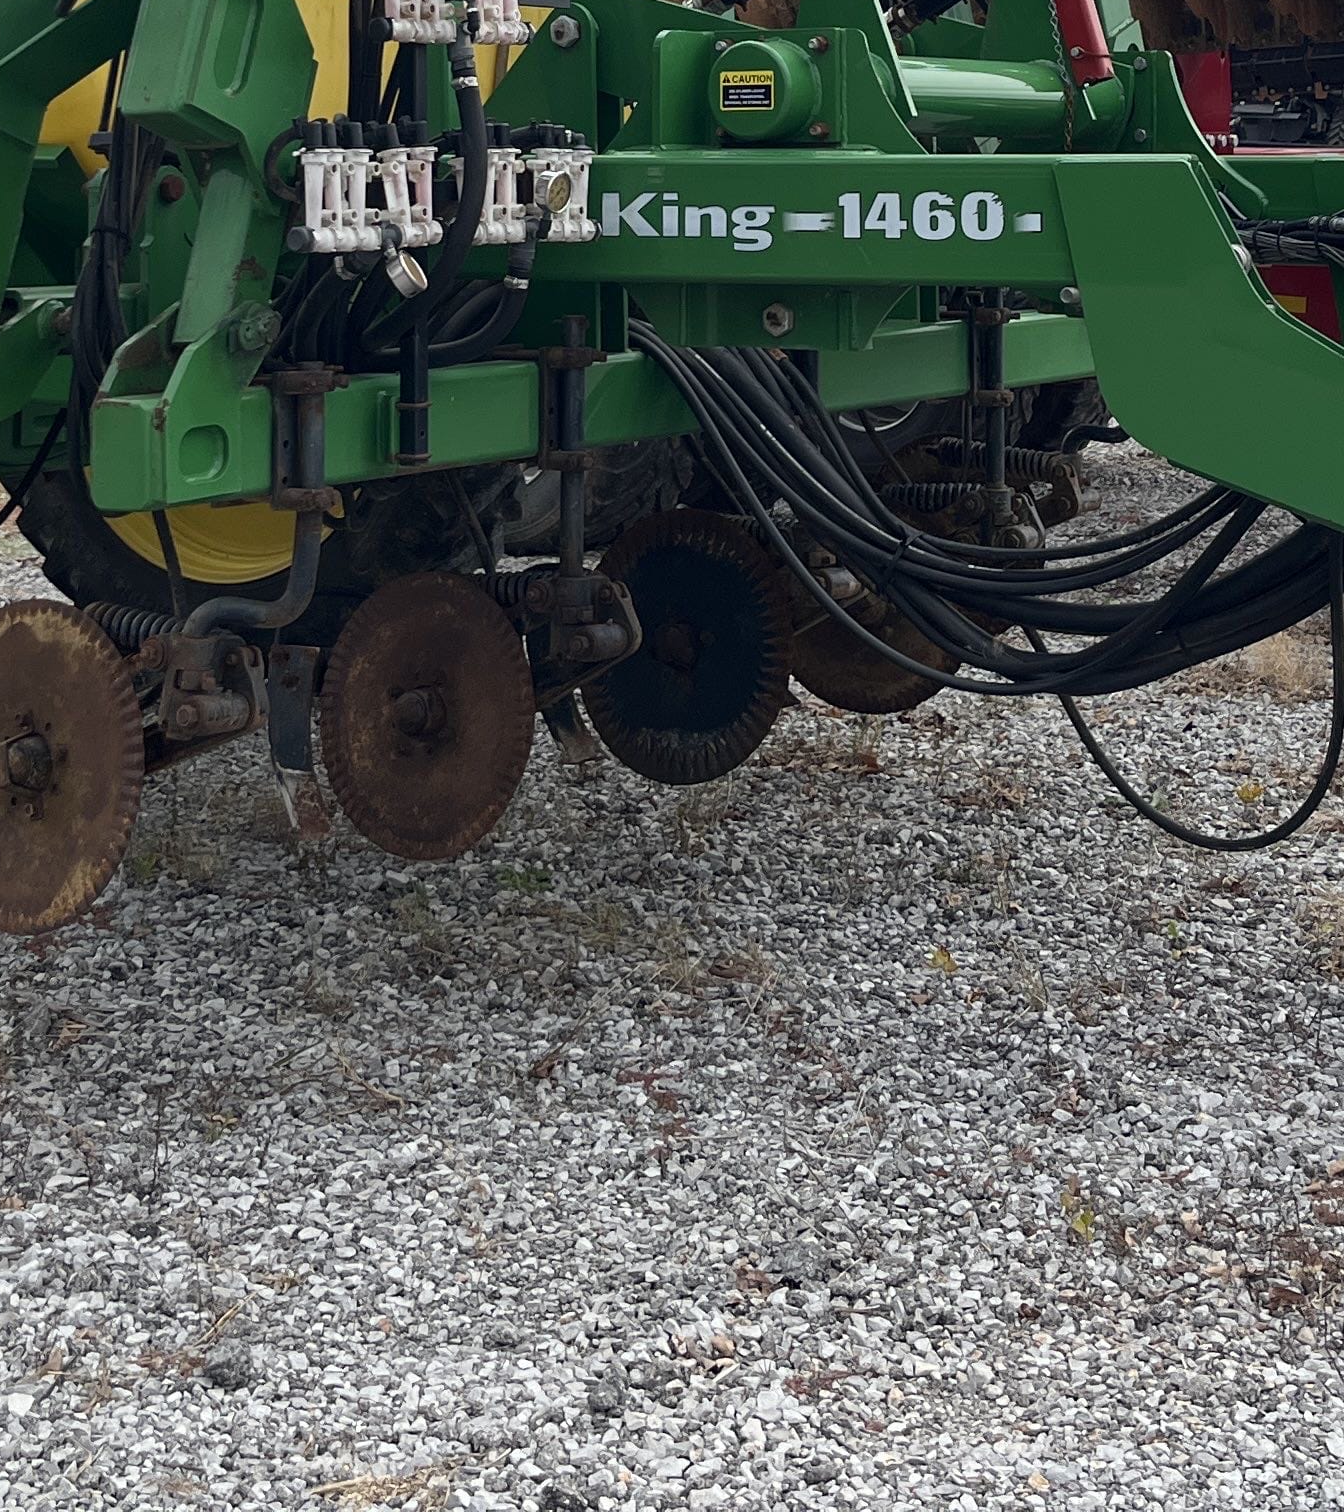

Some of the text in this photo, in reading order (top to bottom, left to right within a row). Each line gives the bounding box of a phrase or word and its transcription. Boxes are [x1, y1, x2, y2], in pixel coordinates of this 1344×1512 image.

[732, 75, 773, 84] CAUTION
[601, 191, 1005, 252] King 1460
